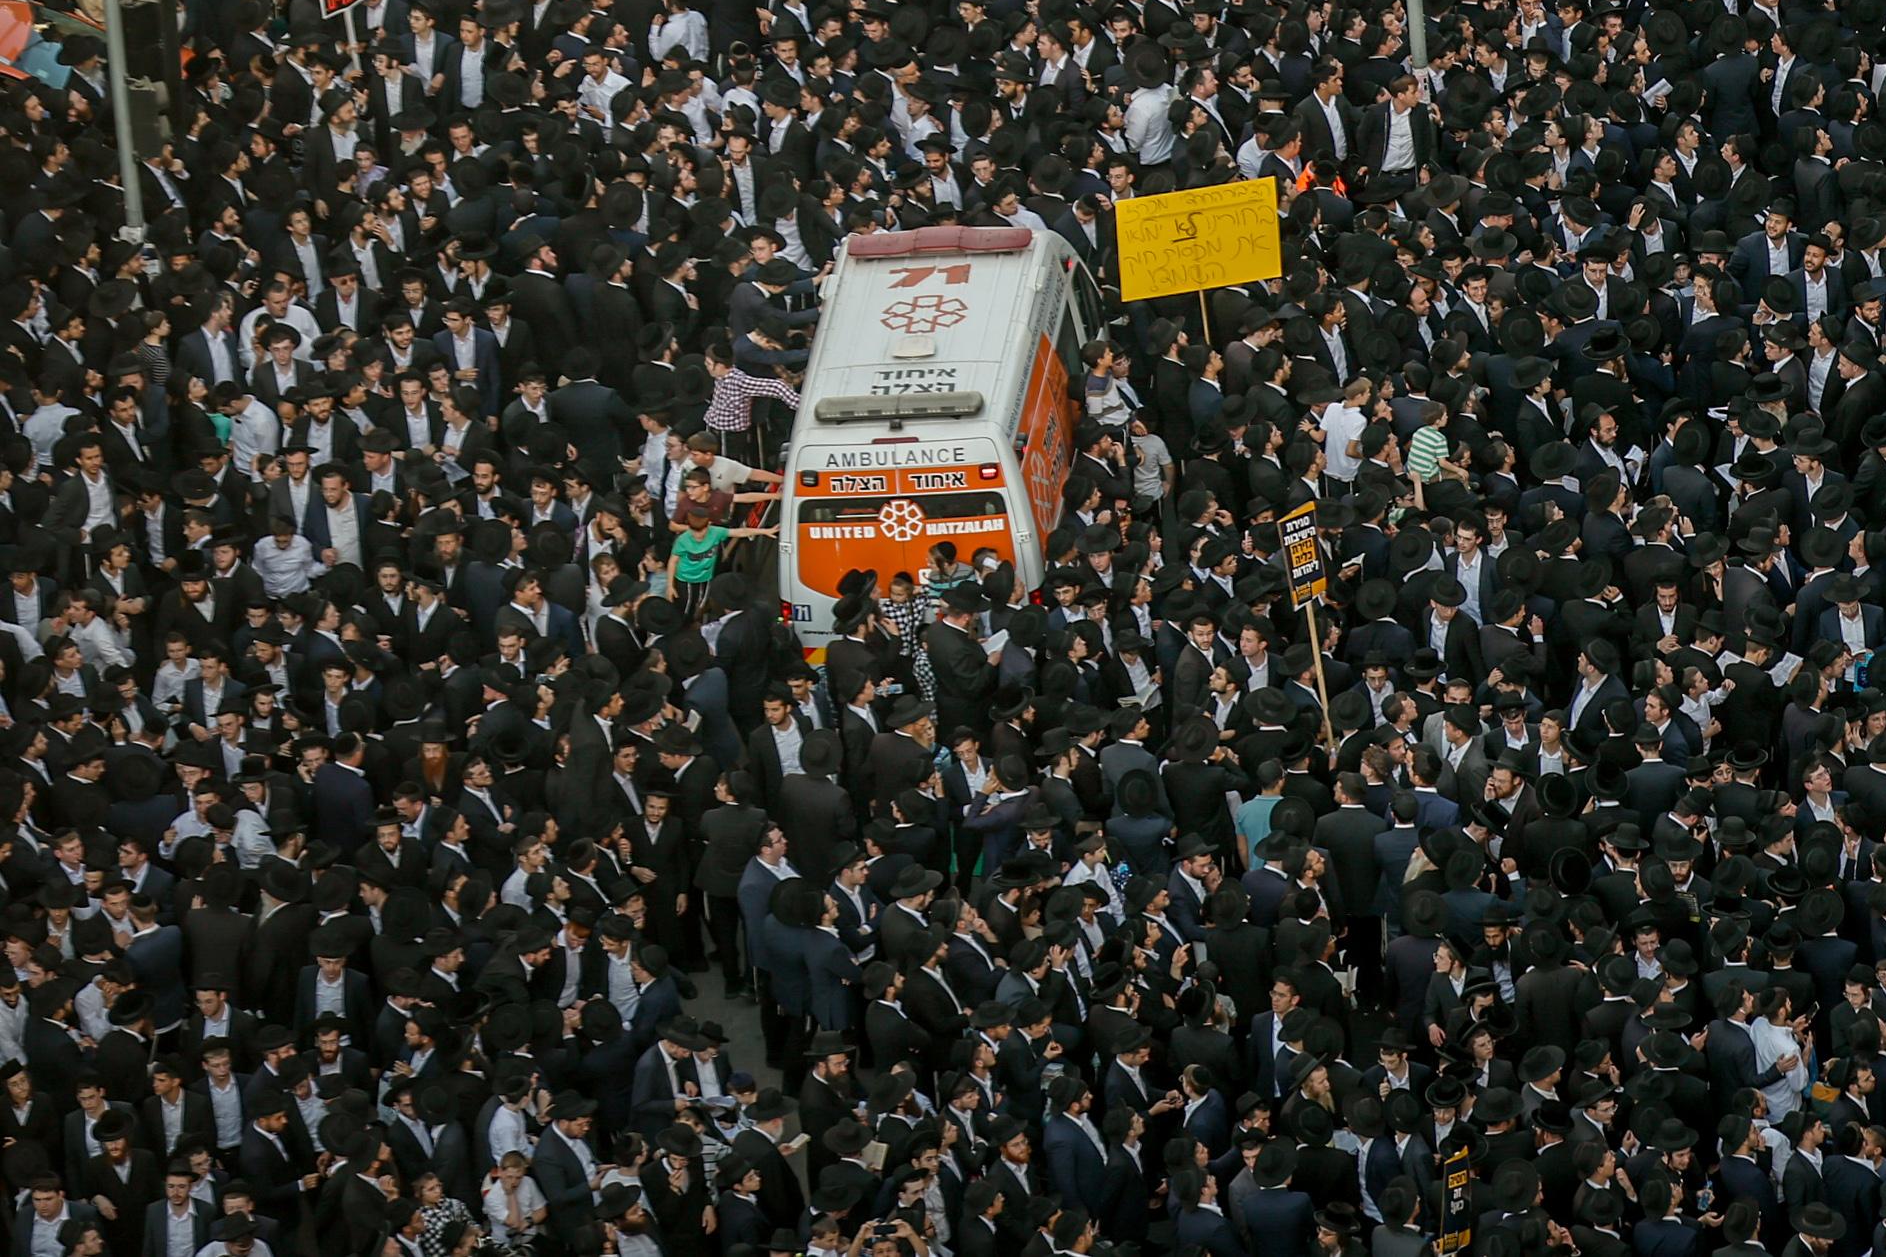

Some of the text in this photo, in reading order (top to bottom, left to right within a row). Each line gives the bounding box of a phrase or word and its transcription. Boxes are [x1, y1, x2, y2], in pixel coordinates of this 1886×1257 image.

[1174, 212, 1204, 238] לא
[1229, 233, 1271, 261] את
[887, 263, 971, 289] 71
[874, 368, 957, 381] איחוד
[870, 382, 956, 396] הצלה
[826, 447, 966, 468] AMBULANCE
[830, 472, 966, 492] איחוד הצלה
[809, 518, 1005, 539] UNITED HATZALAH
[1285, 515, 1311, 532] סגירת
[1284, 526, 1316, 546] הישיבות
[1291, 538, 1313, 554] גזירת
[1295, 550, 1313, 565] כליה
[1292, 559, 1319, 579] ליהדות
[795, 605, 810, 621] 71
